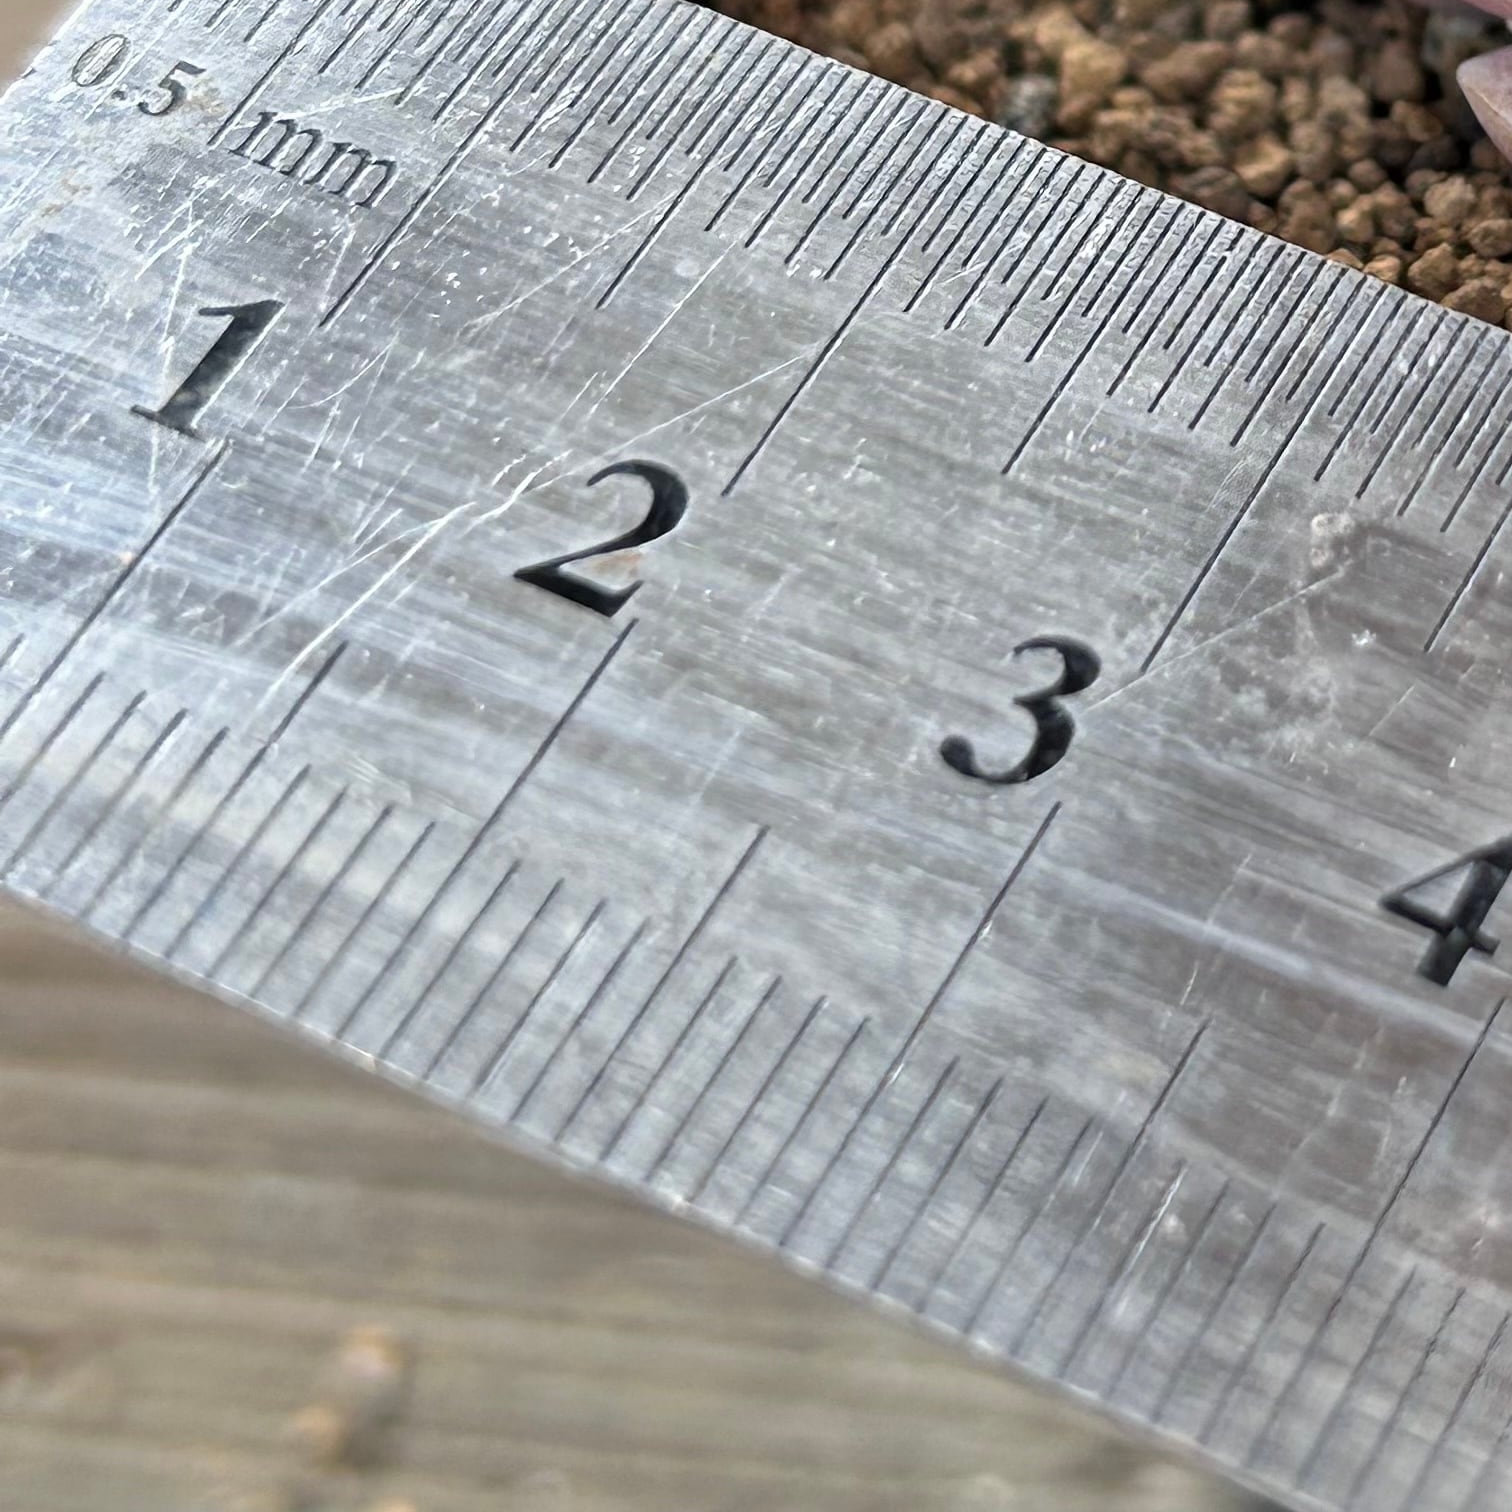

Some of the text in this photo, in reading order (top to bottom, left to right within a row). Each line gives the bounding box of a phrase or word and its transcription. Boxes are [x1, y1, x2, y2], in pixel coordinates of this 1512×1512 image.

[228, 111, 397, 209] mm
[130, 299, 286, 439] 1
[513, 458, 690, 617] 2
[939, 634, 1103, 785] 3
